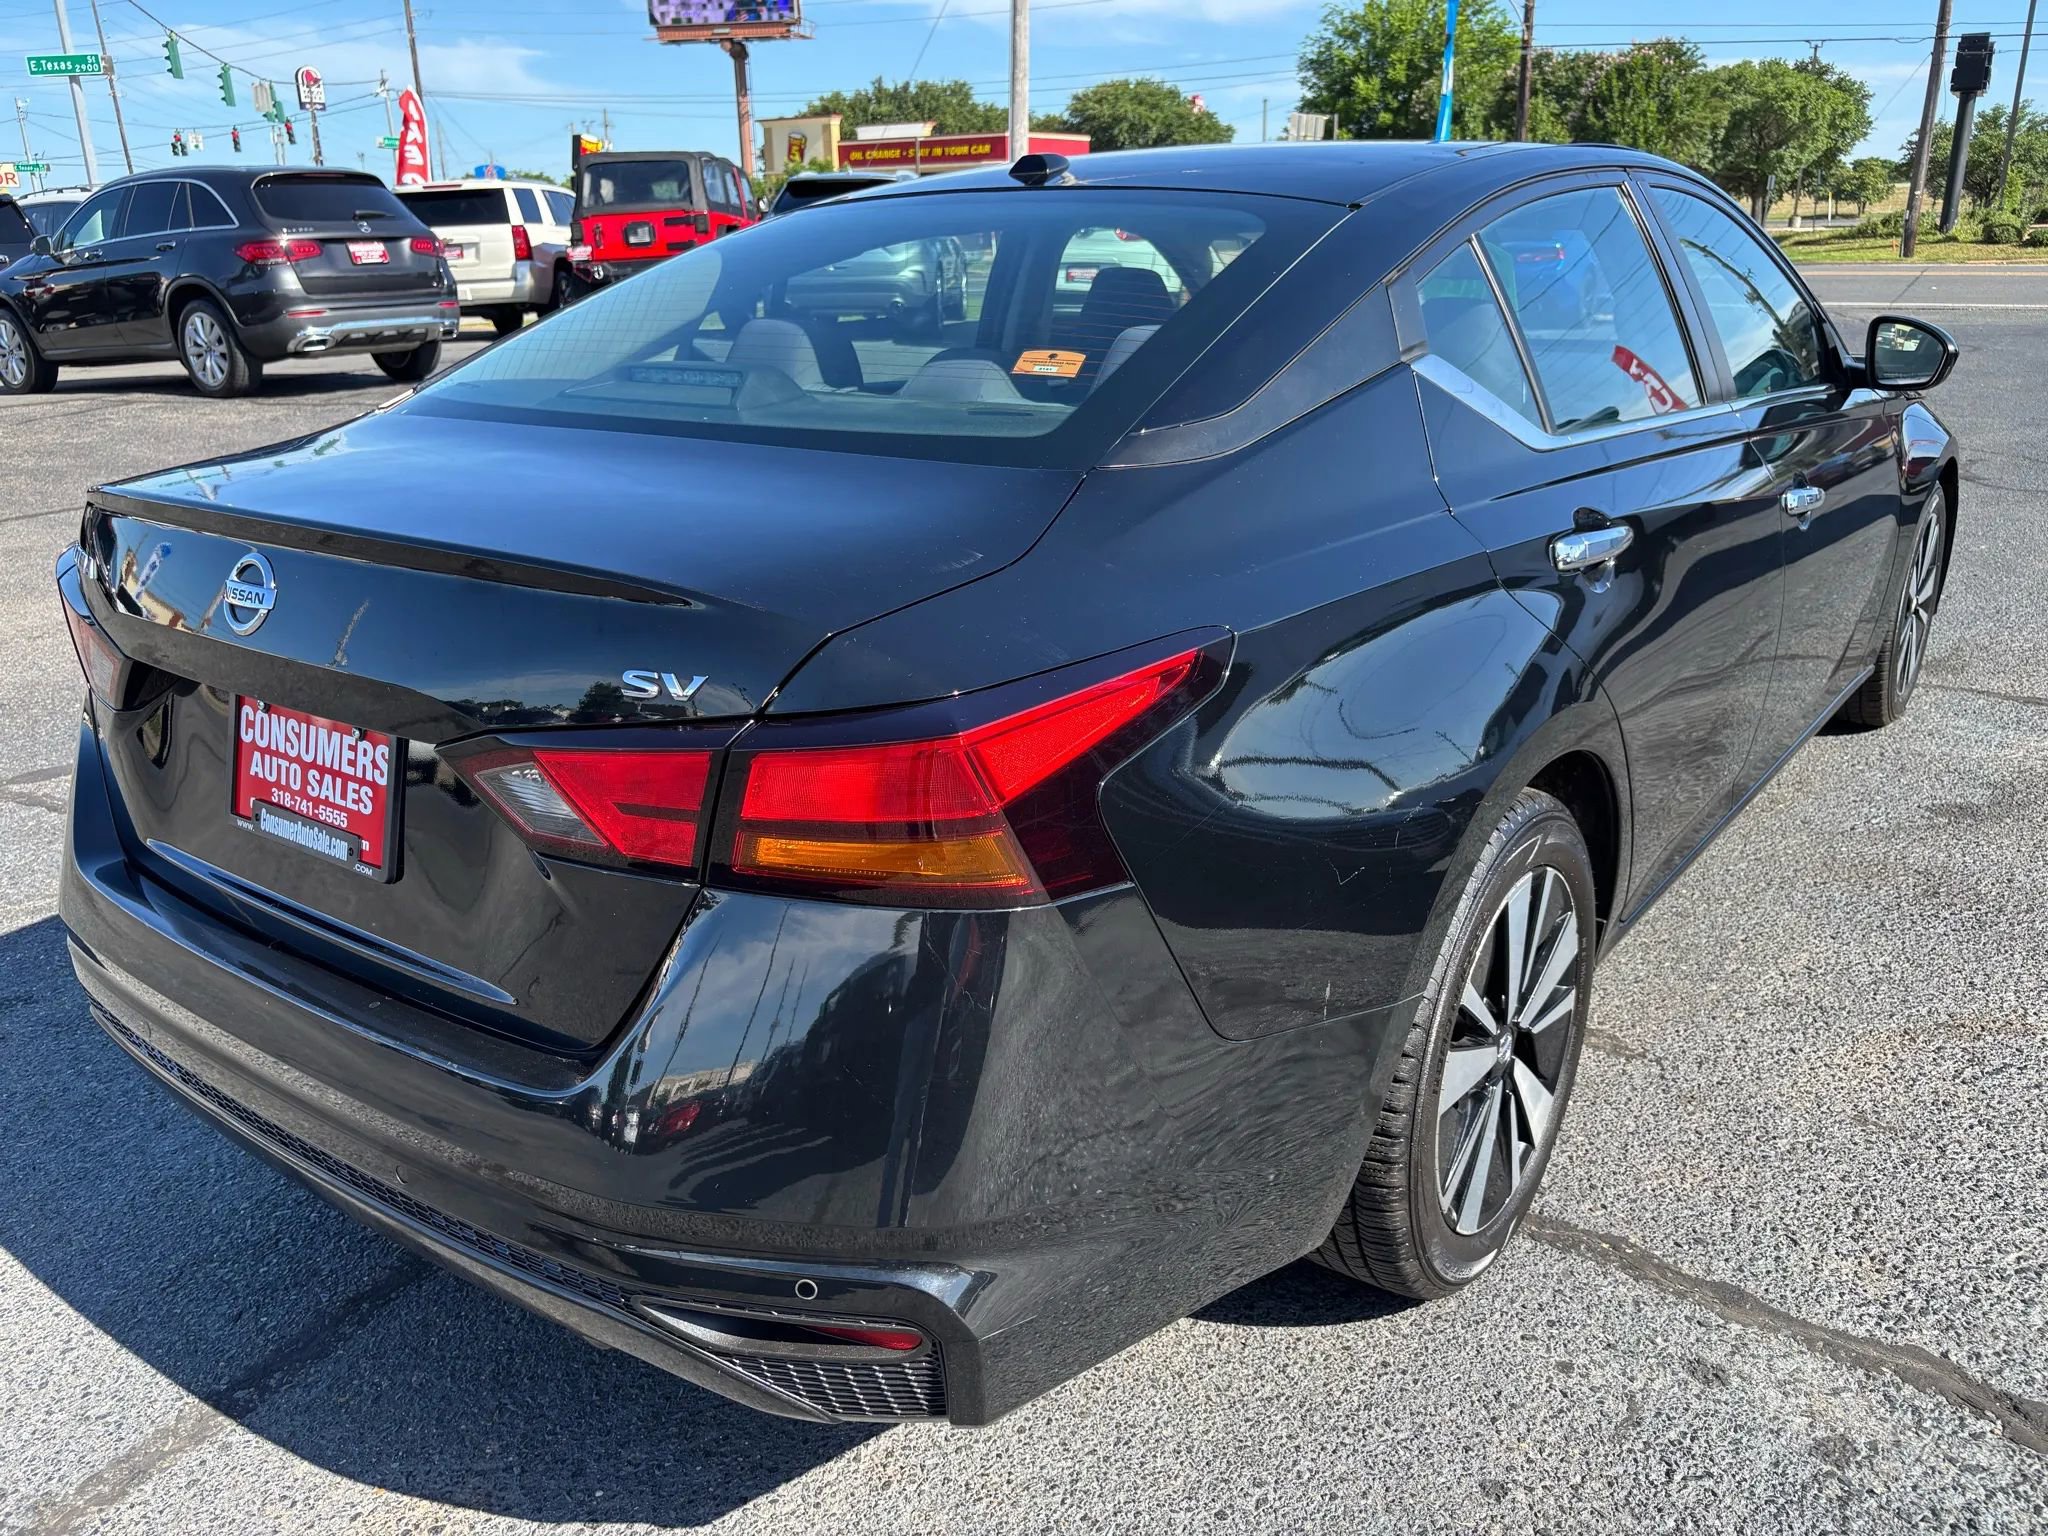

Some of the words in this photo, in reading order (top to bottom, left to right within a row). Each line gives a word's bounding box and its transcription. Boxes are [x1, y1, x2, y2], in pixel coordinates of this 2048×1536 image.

[74, 63, 99, 73] 2900
[86, 55, 96, 64] St
[849, 150, 863, 161] OIL
[865, 149, 901, 160] CHANGE
[907, 148, 930, 158] SAY
[932, 147, 943, 157] IN
[944, 145, 970, 156] YOUR
[970, 144, 992, 155] CAR
[621, 669, 709, 701] SV
[240, 705, 389, 785] CONSUMERS
[250, 751, 301, 791] AUTO
[307, 770, 373, 815] SALES
[271, 788, 348, 828] 318-741-5555
[260, 808, 348, 862] ConsumerAutoSale.com
